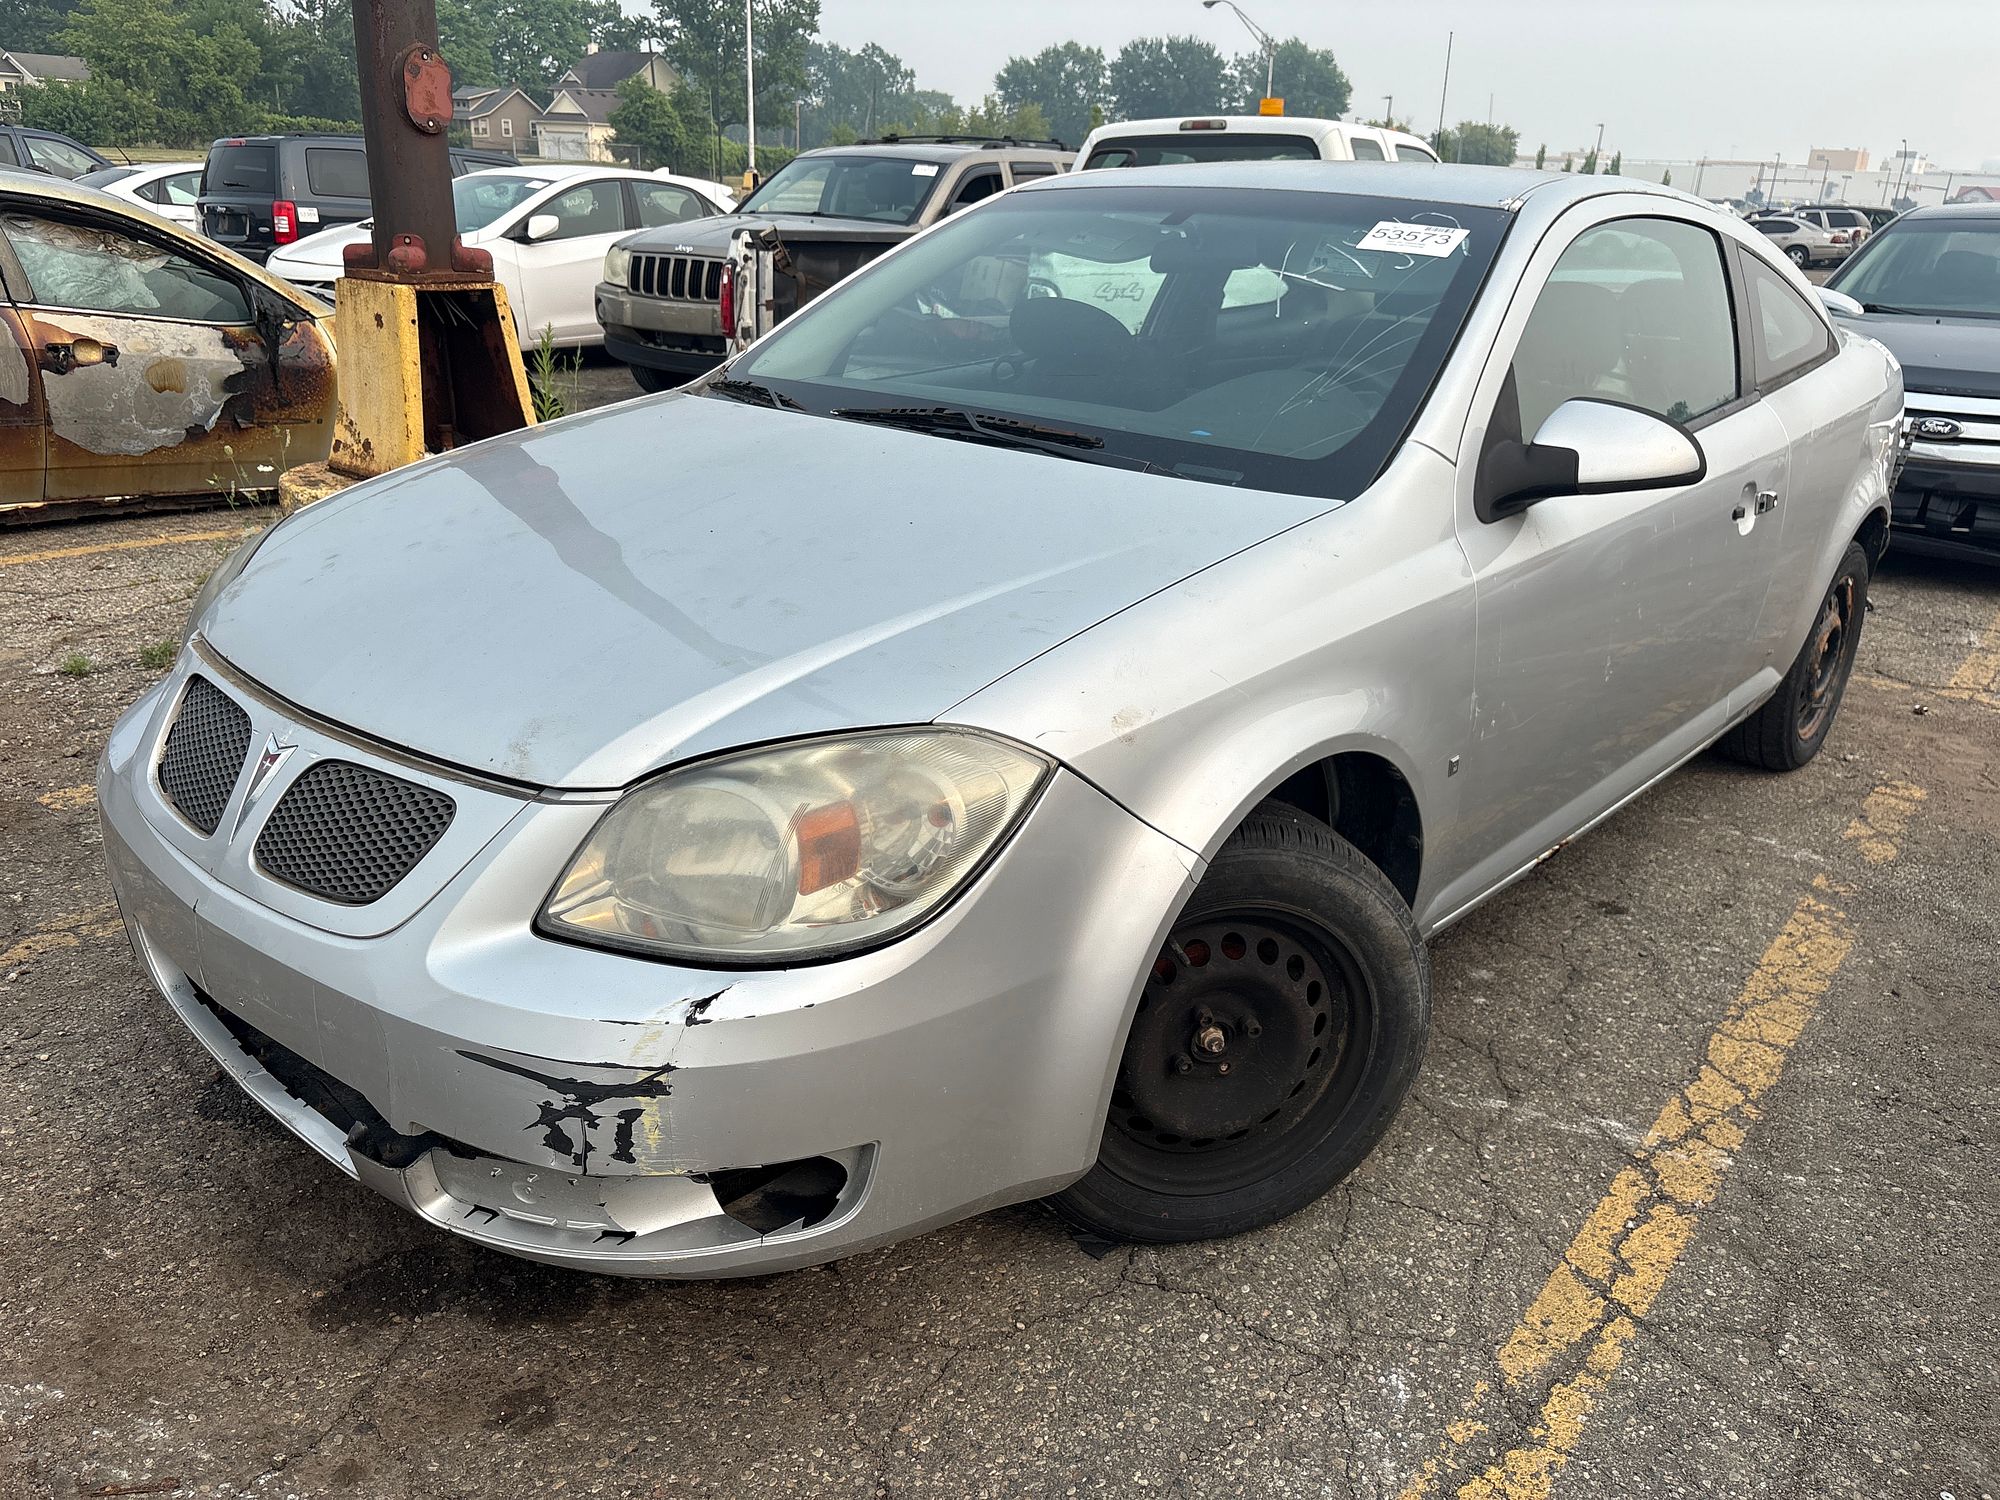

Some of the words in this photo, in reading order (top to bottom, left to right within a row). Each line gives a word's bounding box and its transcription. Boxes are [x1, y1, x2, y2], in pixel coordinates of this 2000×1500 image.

[1372, 228, 1452, 245] 53573
[1094, 281, 1144, 302] 4x4
[1921, 419, 1952, 434] Ford
